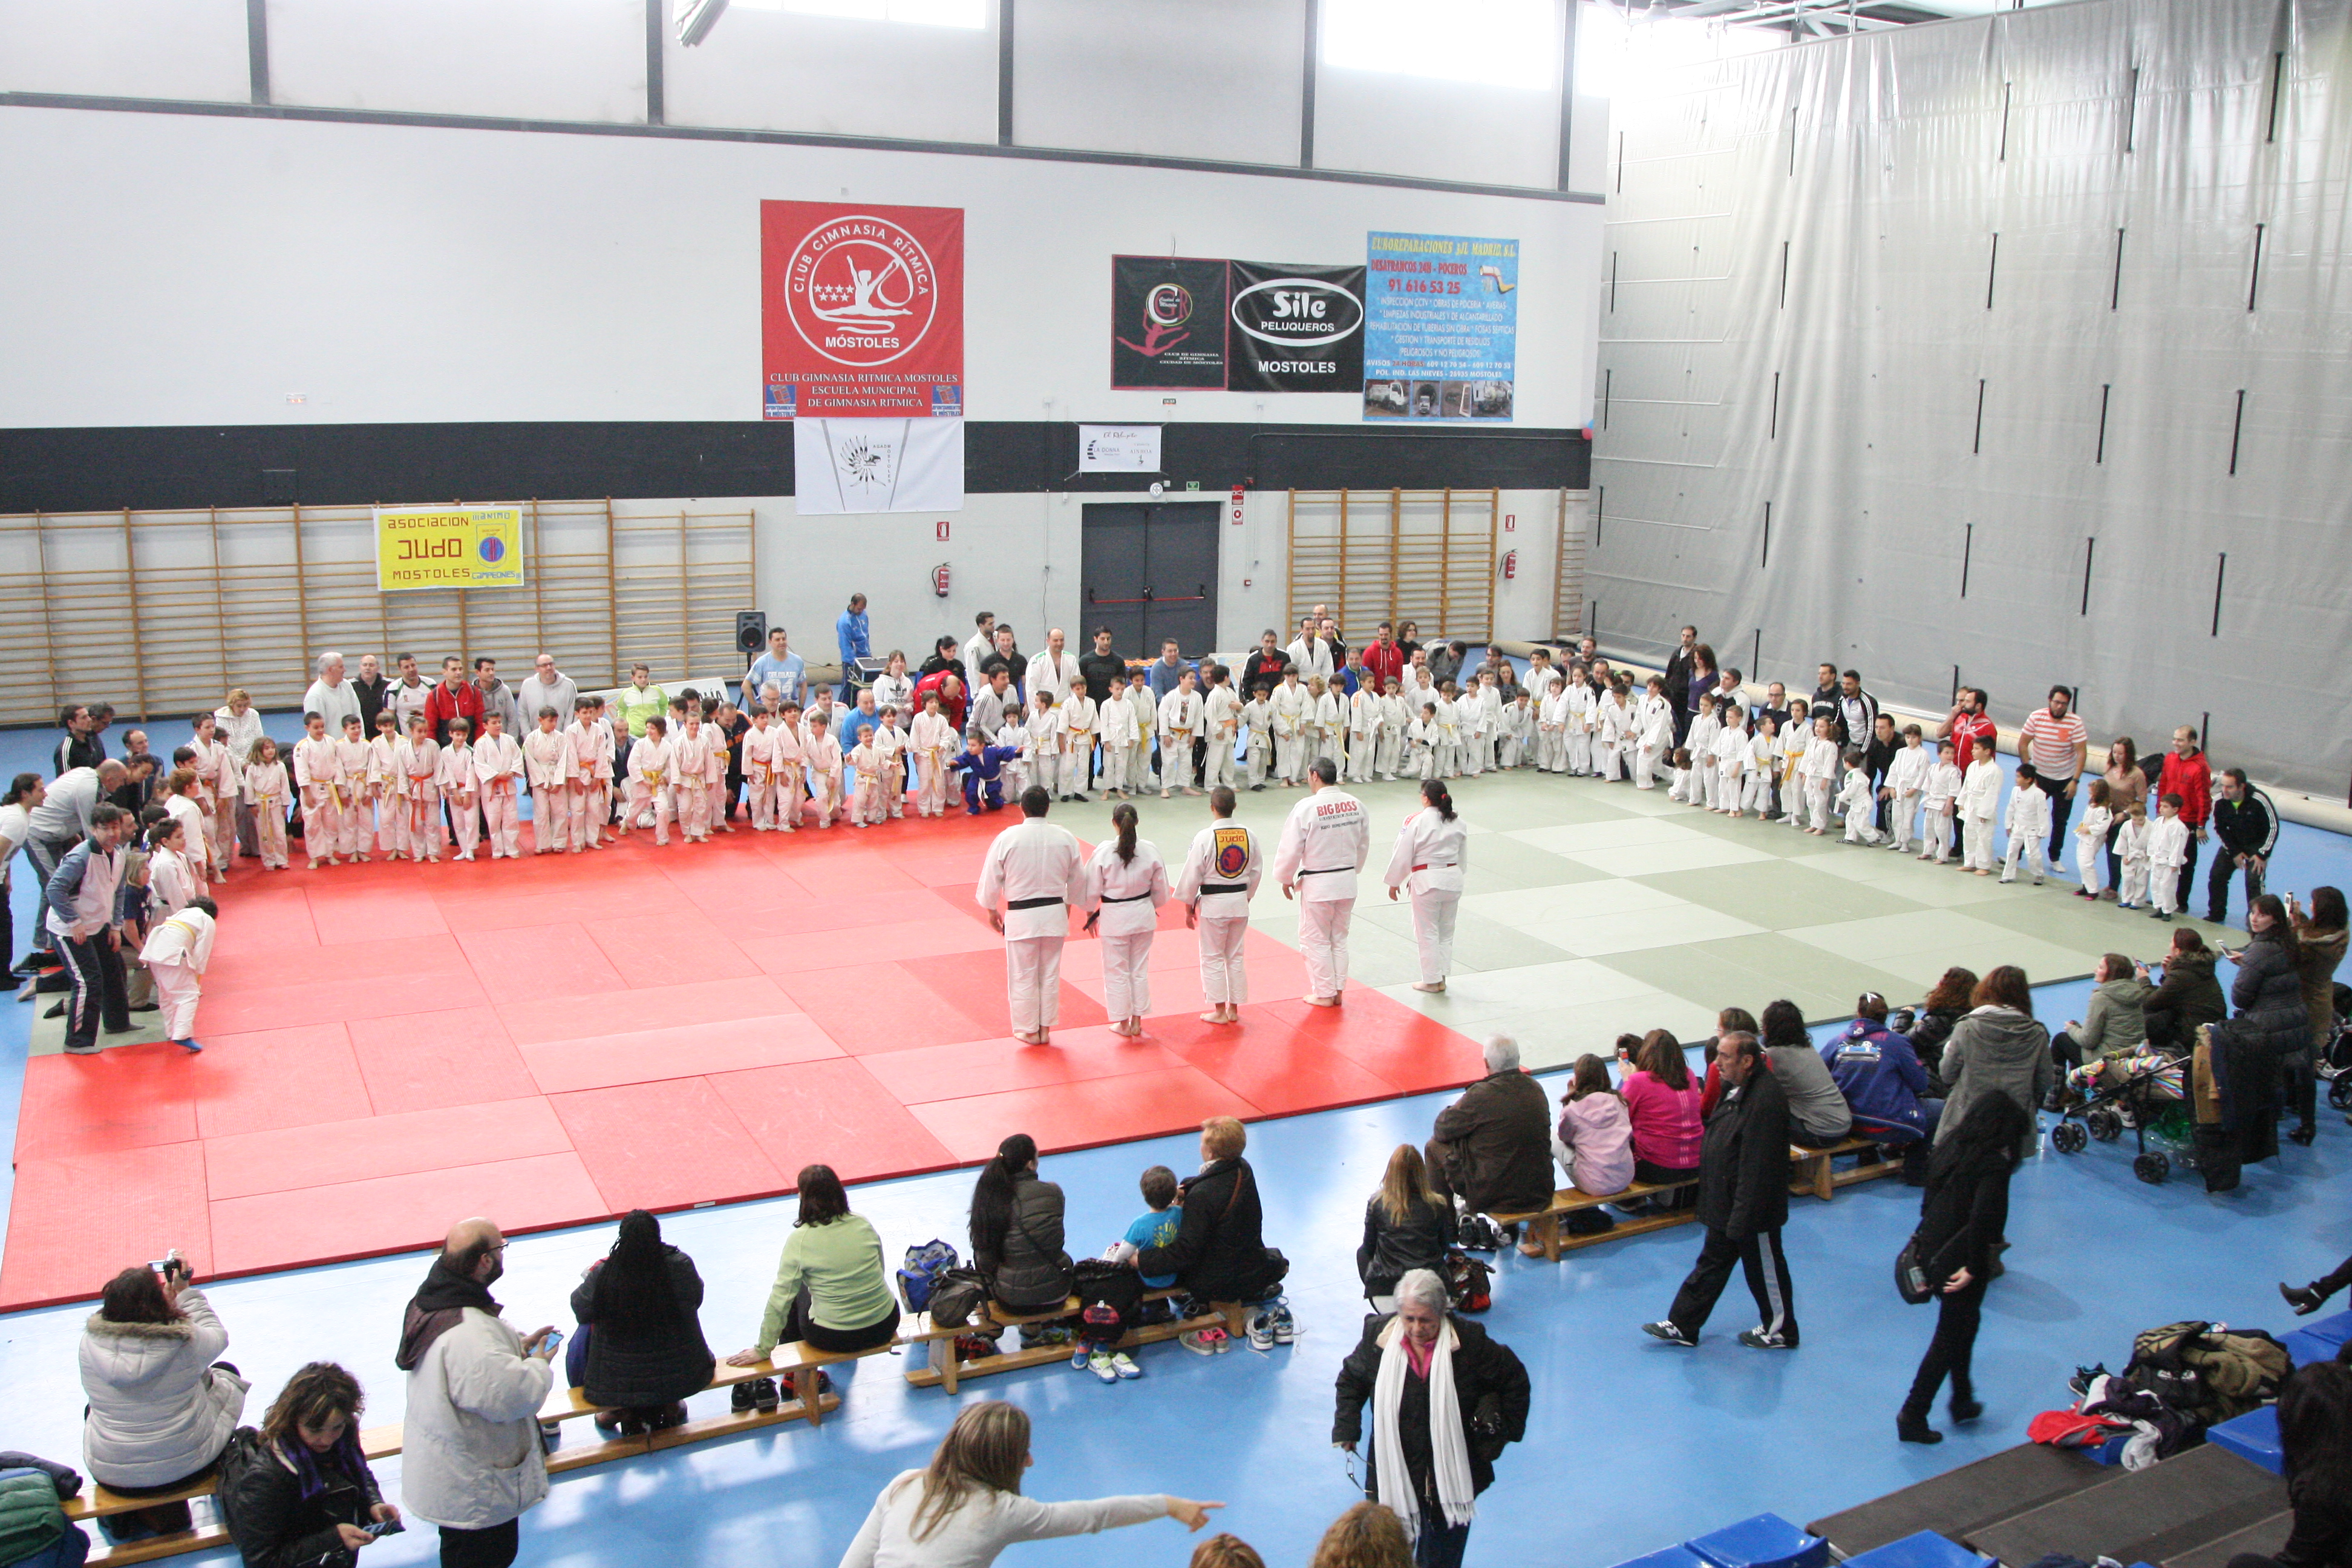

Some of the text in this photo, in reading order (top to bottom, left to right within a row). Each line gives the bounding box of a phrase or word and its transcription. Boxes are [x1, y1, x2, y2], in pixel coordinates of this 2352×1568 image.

[1371, 237, 1452, 253] EUROREPARACIONES
[794, 224, 929, 296] CLUB GIMNASIA RÍTMICA
[1371, 258, 1417, 273] DESATRANCOS
[1438, 262, 1468, 275] POCEROS
[1388, 278, 1461, 294] 91 616 53 25
[1261, 321, 1335, 332] PELUQUEROS
[825, 334, 900, 348] MÓSTOLES
[1258, 361, 1337, 374] MOSTOLES
[770, 373, 958, 383] CLUB GIMNASIA RITMICA MOSTOLES
[811, 385, 919, 395] ESCUELA MUNICIPAL
[808, 398, 924, 407] DE GIMNASIA RITMICA
[393, 567, 470, 580] MOSTOLES
[1316, 803, 1334, 817] BIG
[1334, 800, 1357, 814] BOSS
